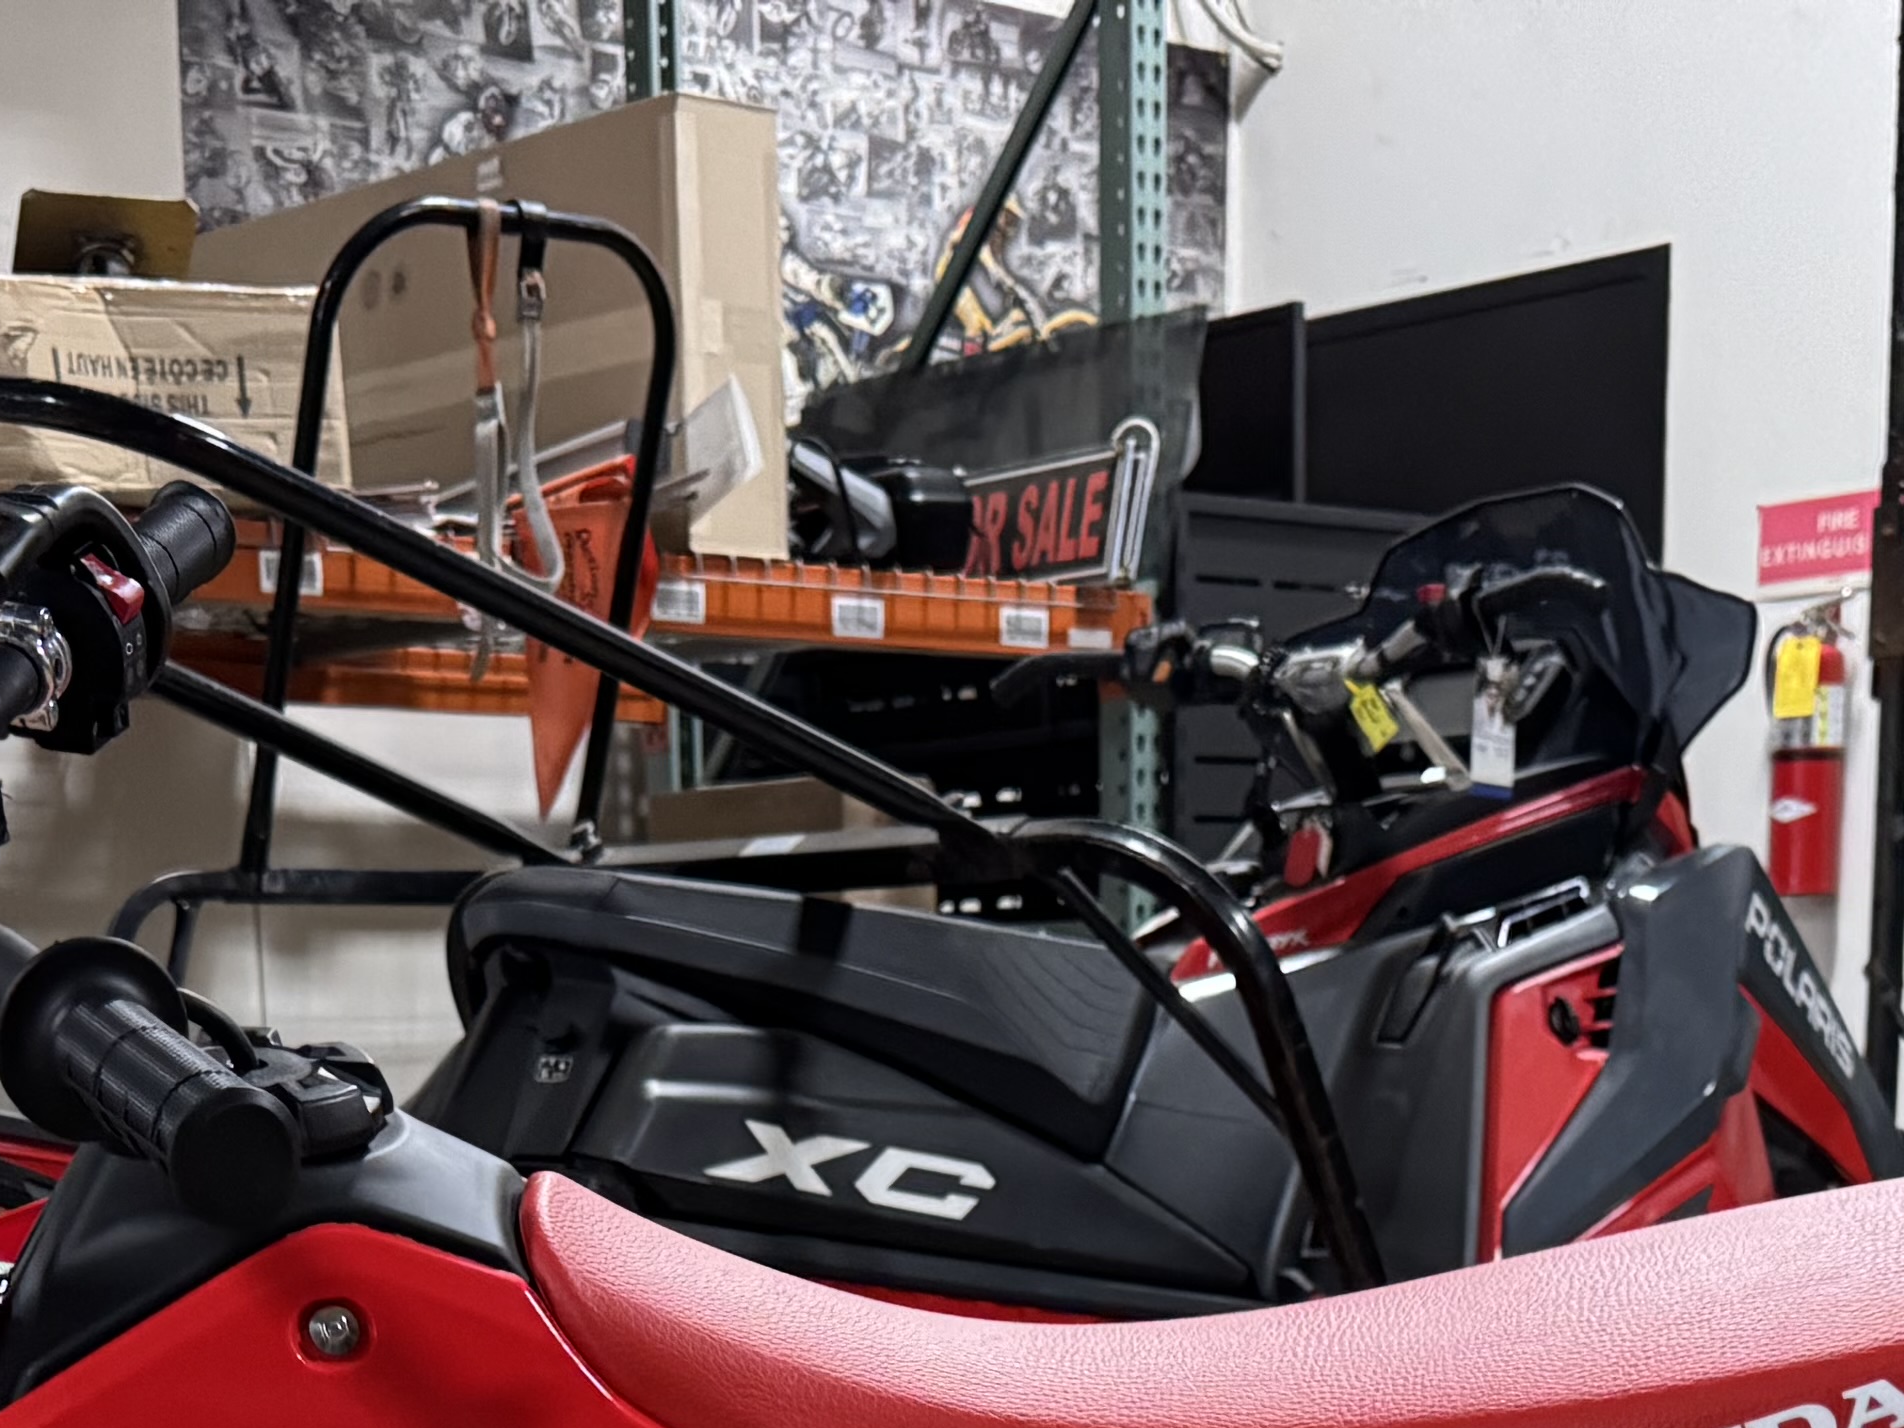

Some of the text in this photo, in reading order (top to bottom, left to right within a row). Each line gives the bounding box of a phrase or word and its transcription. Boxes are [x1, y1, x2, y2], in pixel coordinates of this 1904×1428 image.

[1011, 469, 1110, 572] SALE
[1759, 531, 1869, 568] EXTINGUIS
[1816, 506, 1860, 534] FIRE
[1745, 890, 1856, 1079] POLARIS
[703, 1118, 997, 1221] XC
